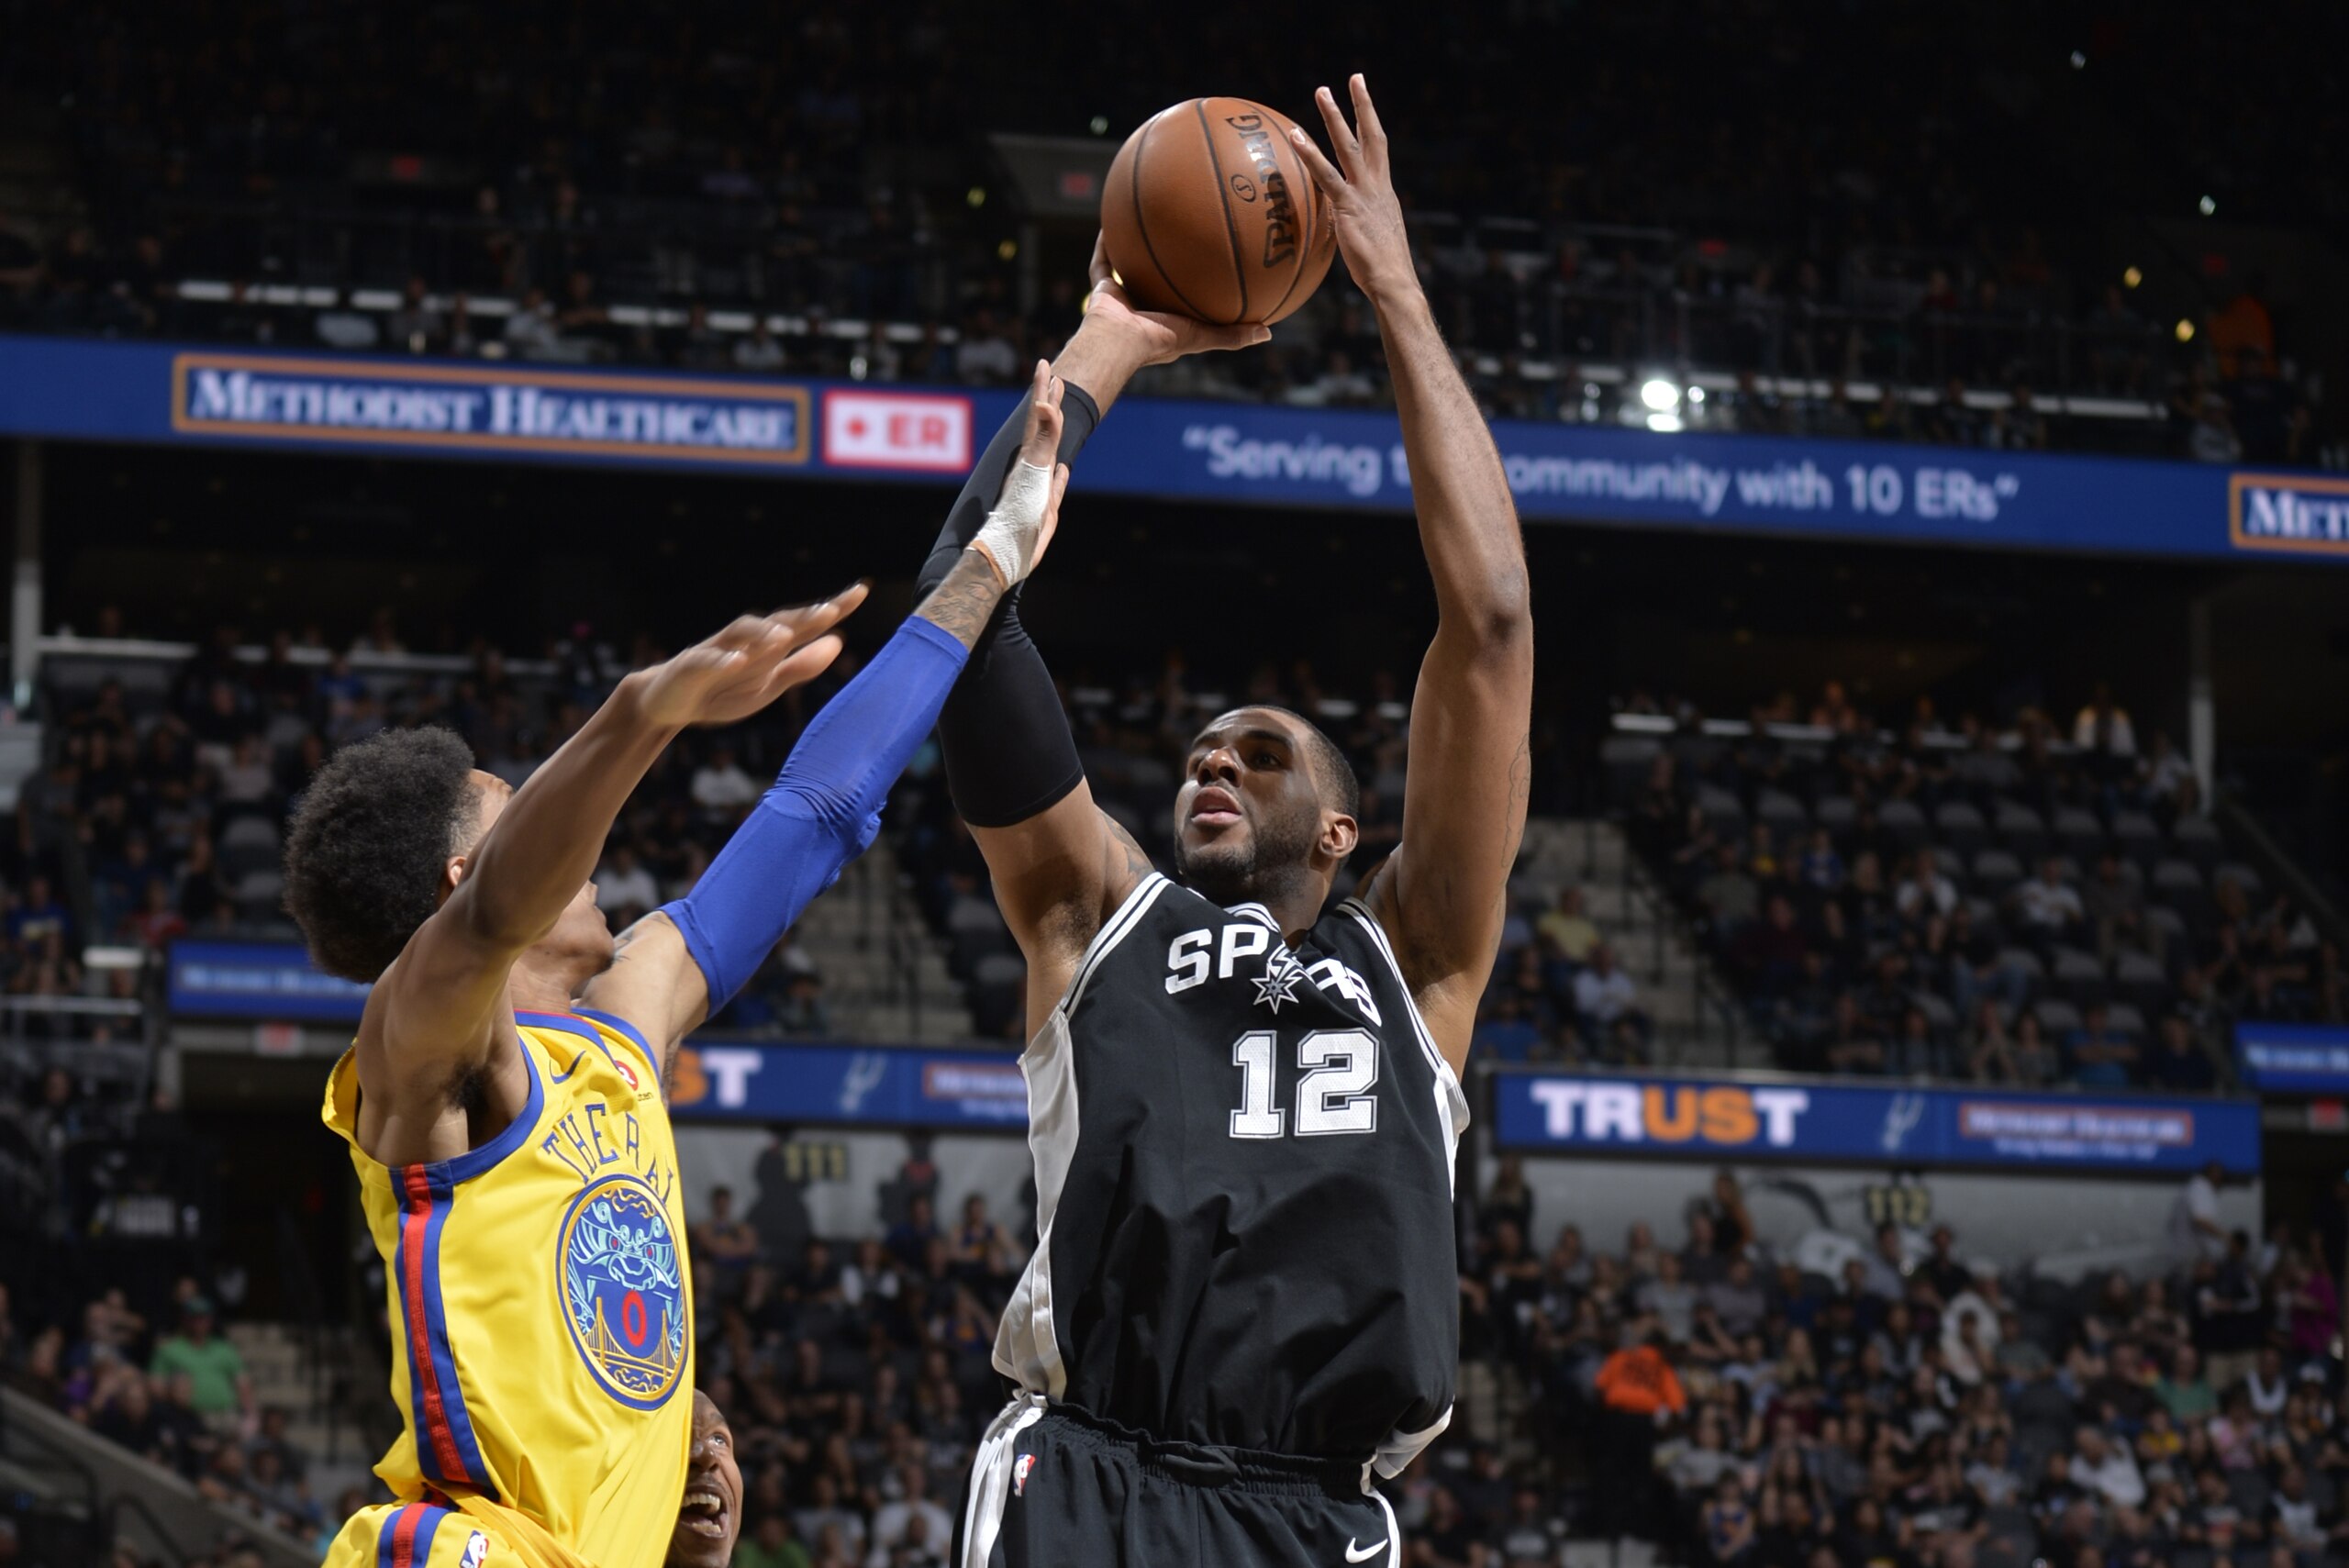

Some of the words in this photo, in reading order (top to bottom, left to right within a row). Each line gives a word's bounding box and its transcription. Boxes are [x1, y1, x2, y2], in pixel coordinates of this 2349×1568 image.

[1225, 114, 1297, 269] SPALDING
[190, 369, 484, 433] METHODIST
[487, 384, 796, 451] HEALTHCARE
[886, 412, 950, 449] ER
[1504, 455, 1731, 517] ommunity
[1737, 459, 1833, 510] with
[1845, 464, 1901, 516] 10
[2245, 486, 2349, 541] MET
[1230, 1027, 1379, 1139] 12
[1529, 1078, 1810, 1148] TRUST
[541, 1103, 620, 1186] THE
[621, 1288, 649, 1348] 0
